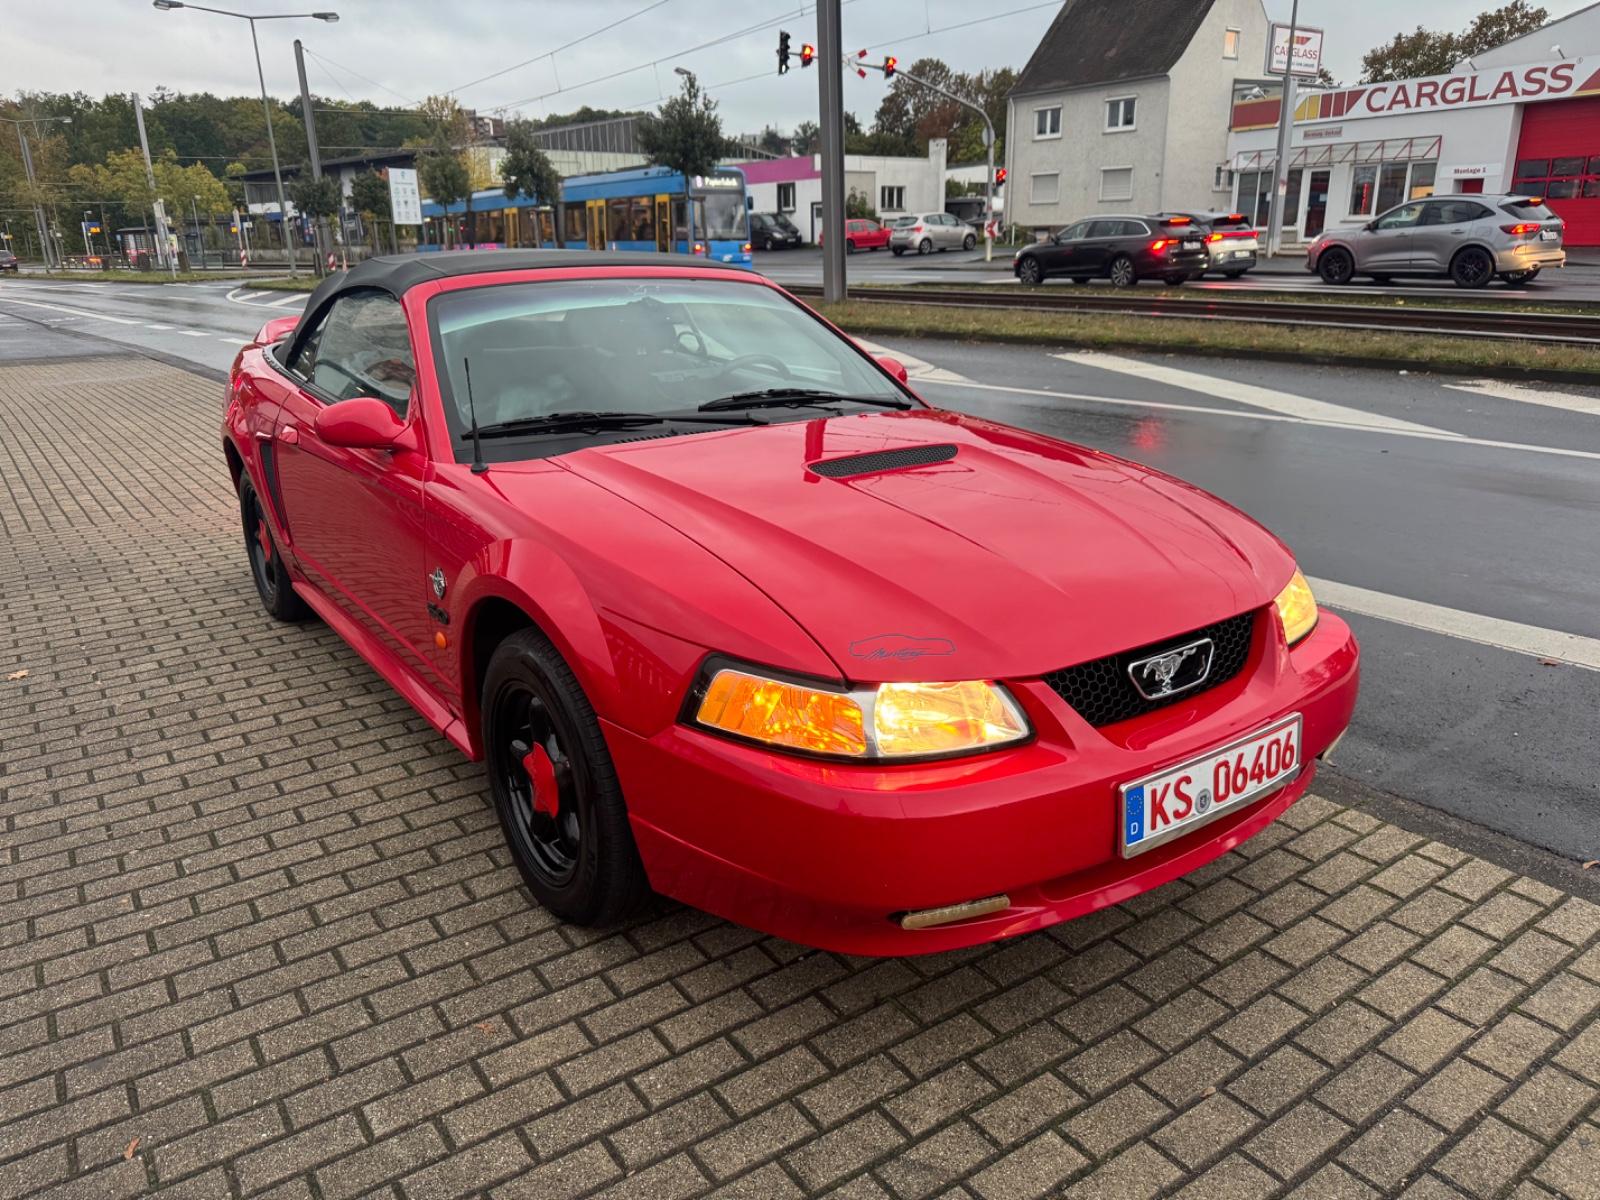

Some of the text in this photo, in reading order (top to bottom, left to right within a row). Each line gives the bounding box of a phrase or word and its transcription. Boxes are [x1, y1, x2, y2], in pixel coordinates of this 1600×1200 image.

[1274, 45, 1318, 60] CAGLASS
[1366, 63, 1576, 113] CARGLASS
[1150, 730, 1295, 831] KS 06406
[1130, 822, 1139, 836] D
